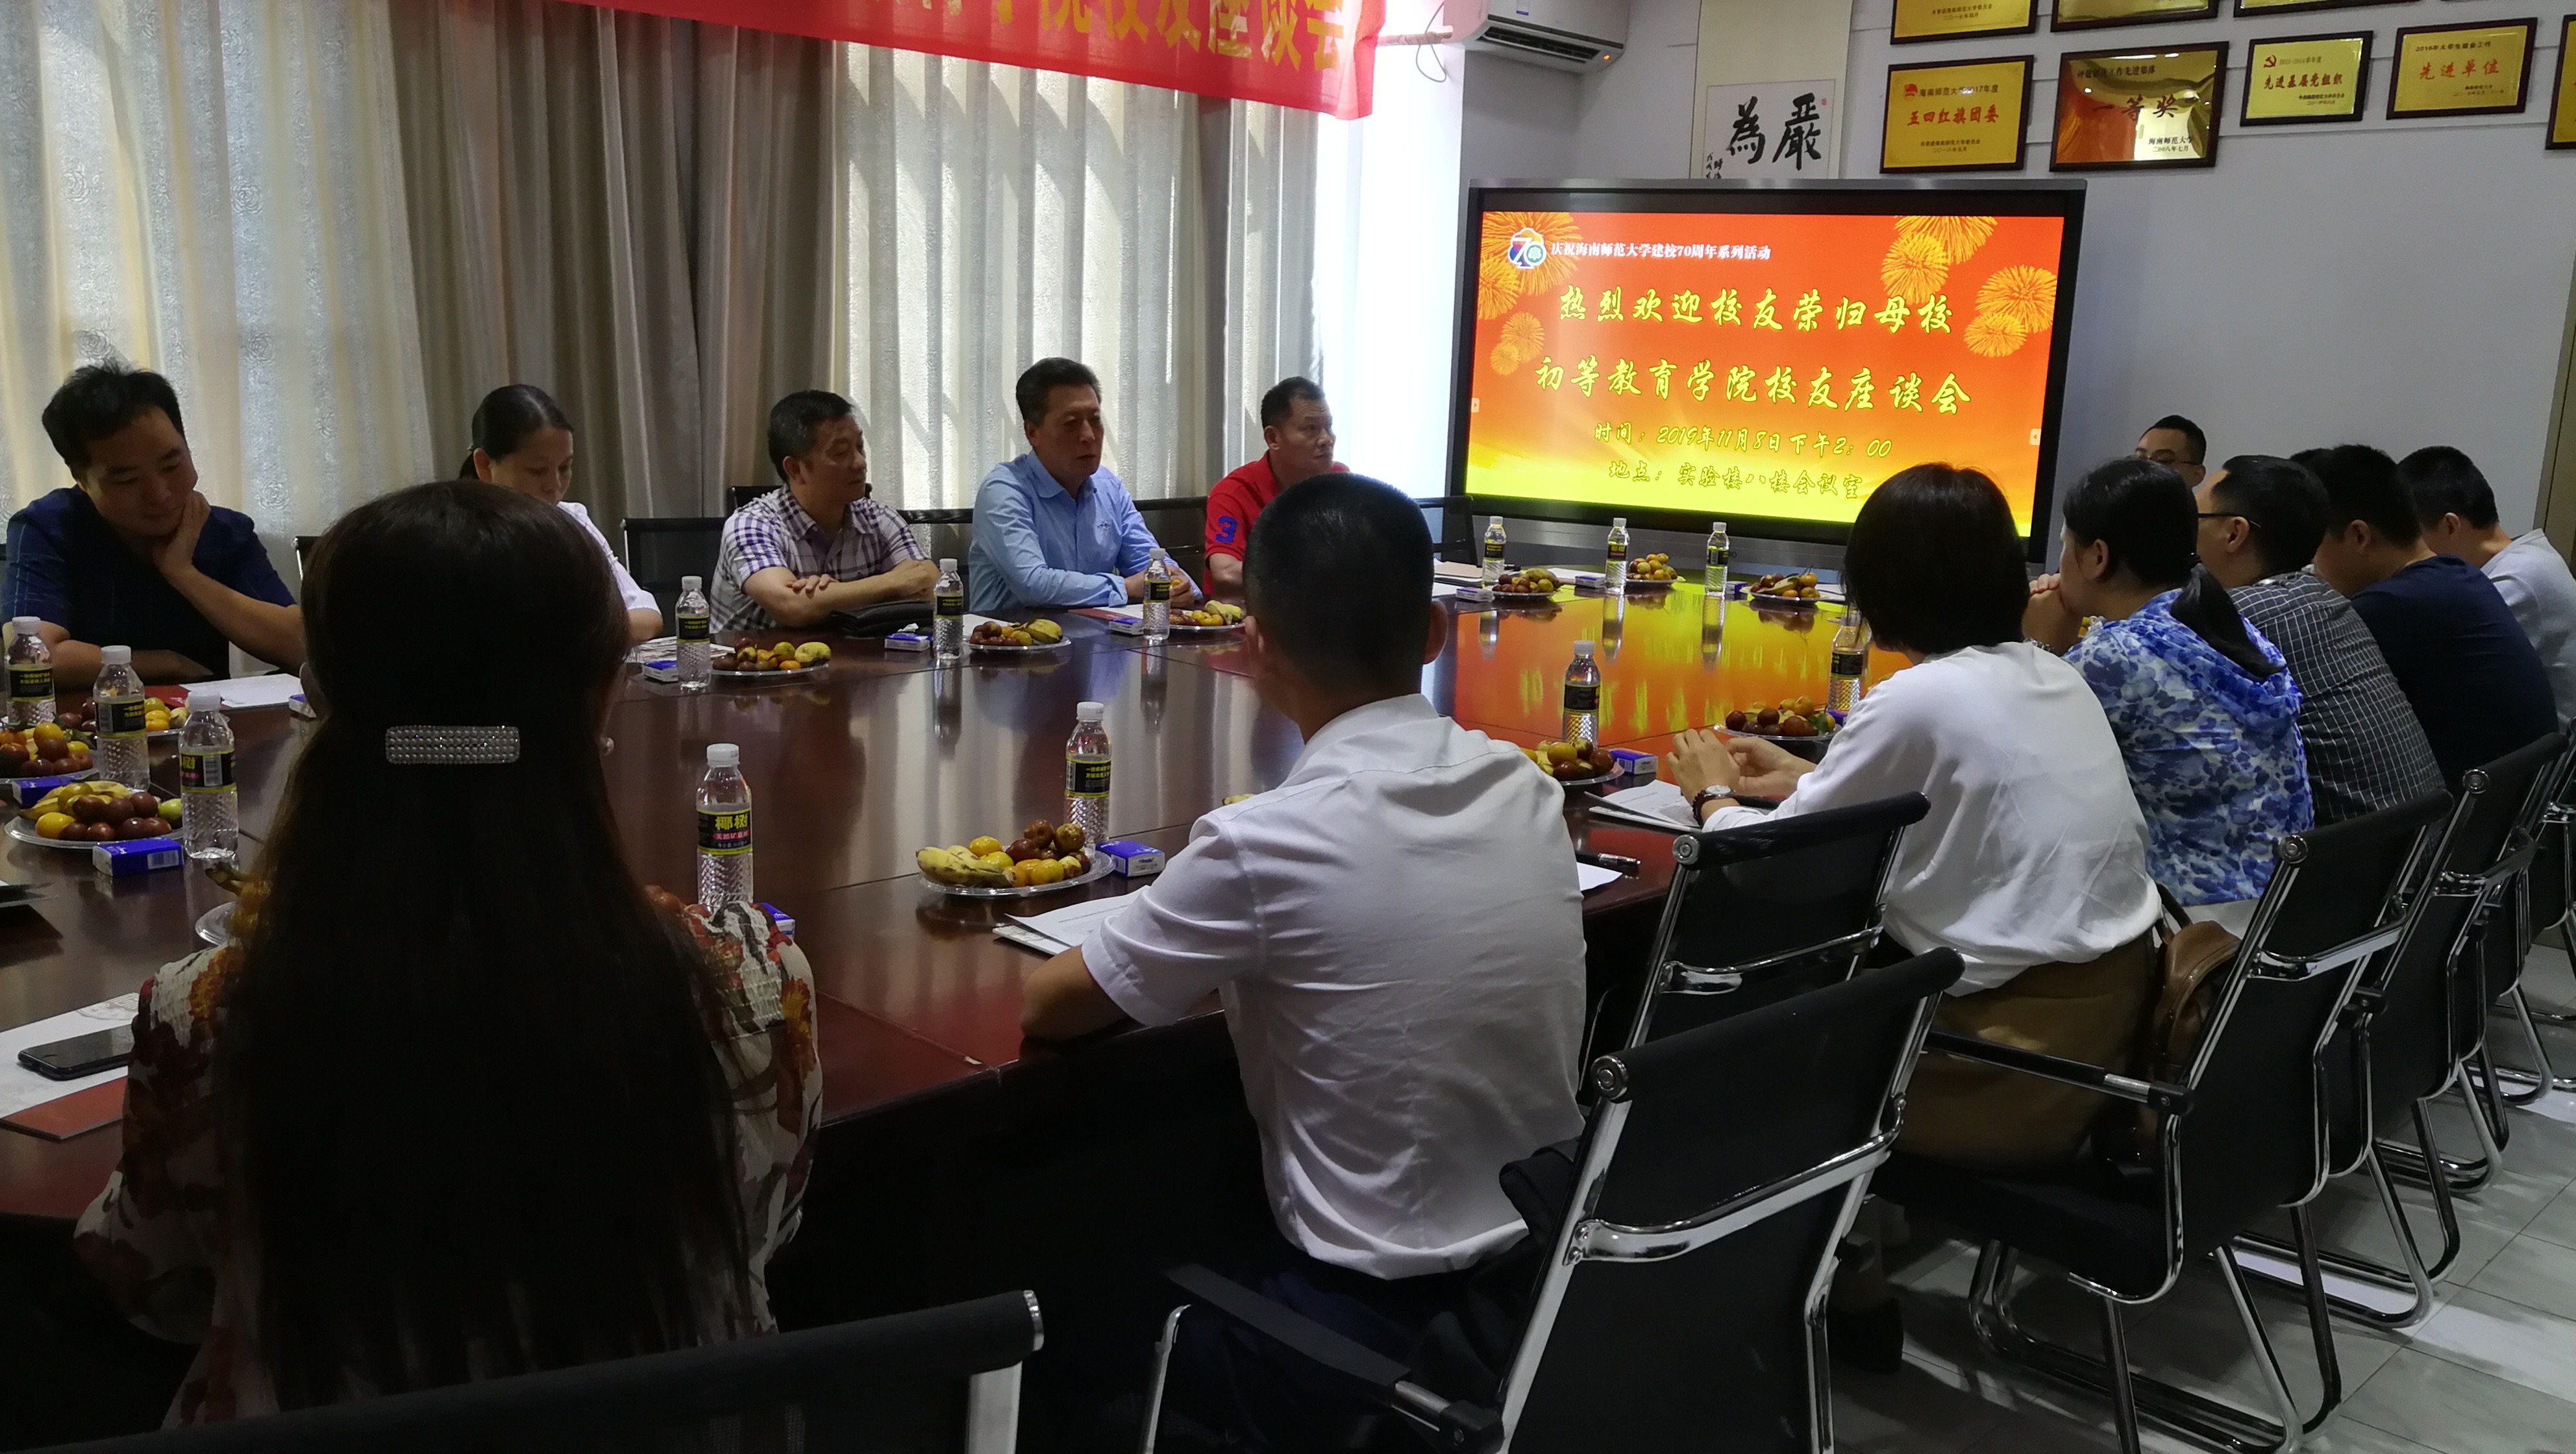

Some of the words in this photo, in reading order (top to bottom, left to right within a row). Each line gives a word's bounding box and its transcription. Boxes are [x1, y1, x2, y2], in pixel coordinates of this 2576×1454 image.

[2264, 73, 2342, 90] 先进基层党组织
[2420, 58, 2499, 80] 先进单位
[1907, 105, 1999, 126] 五四红旗团委
[2093, 93, 2178, 121] 一等奖
[1551, 242, 1771, 260] 庆祝海南师范大学建校70周年系列活动
[1559, 285, 1951, 334] 热烈欢迎校友荣归母校
[1535, 355, 1970, 415] 初等教育学院校友座谈会
[1215, 515, 1237, 543] 3
